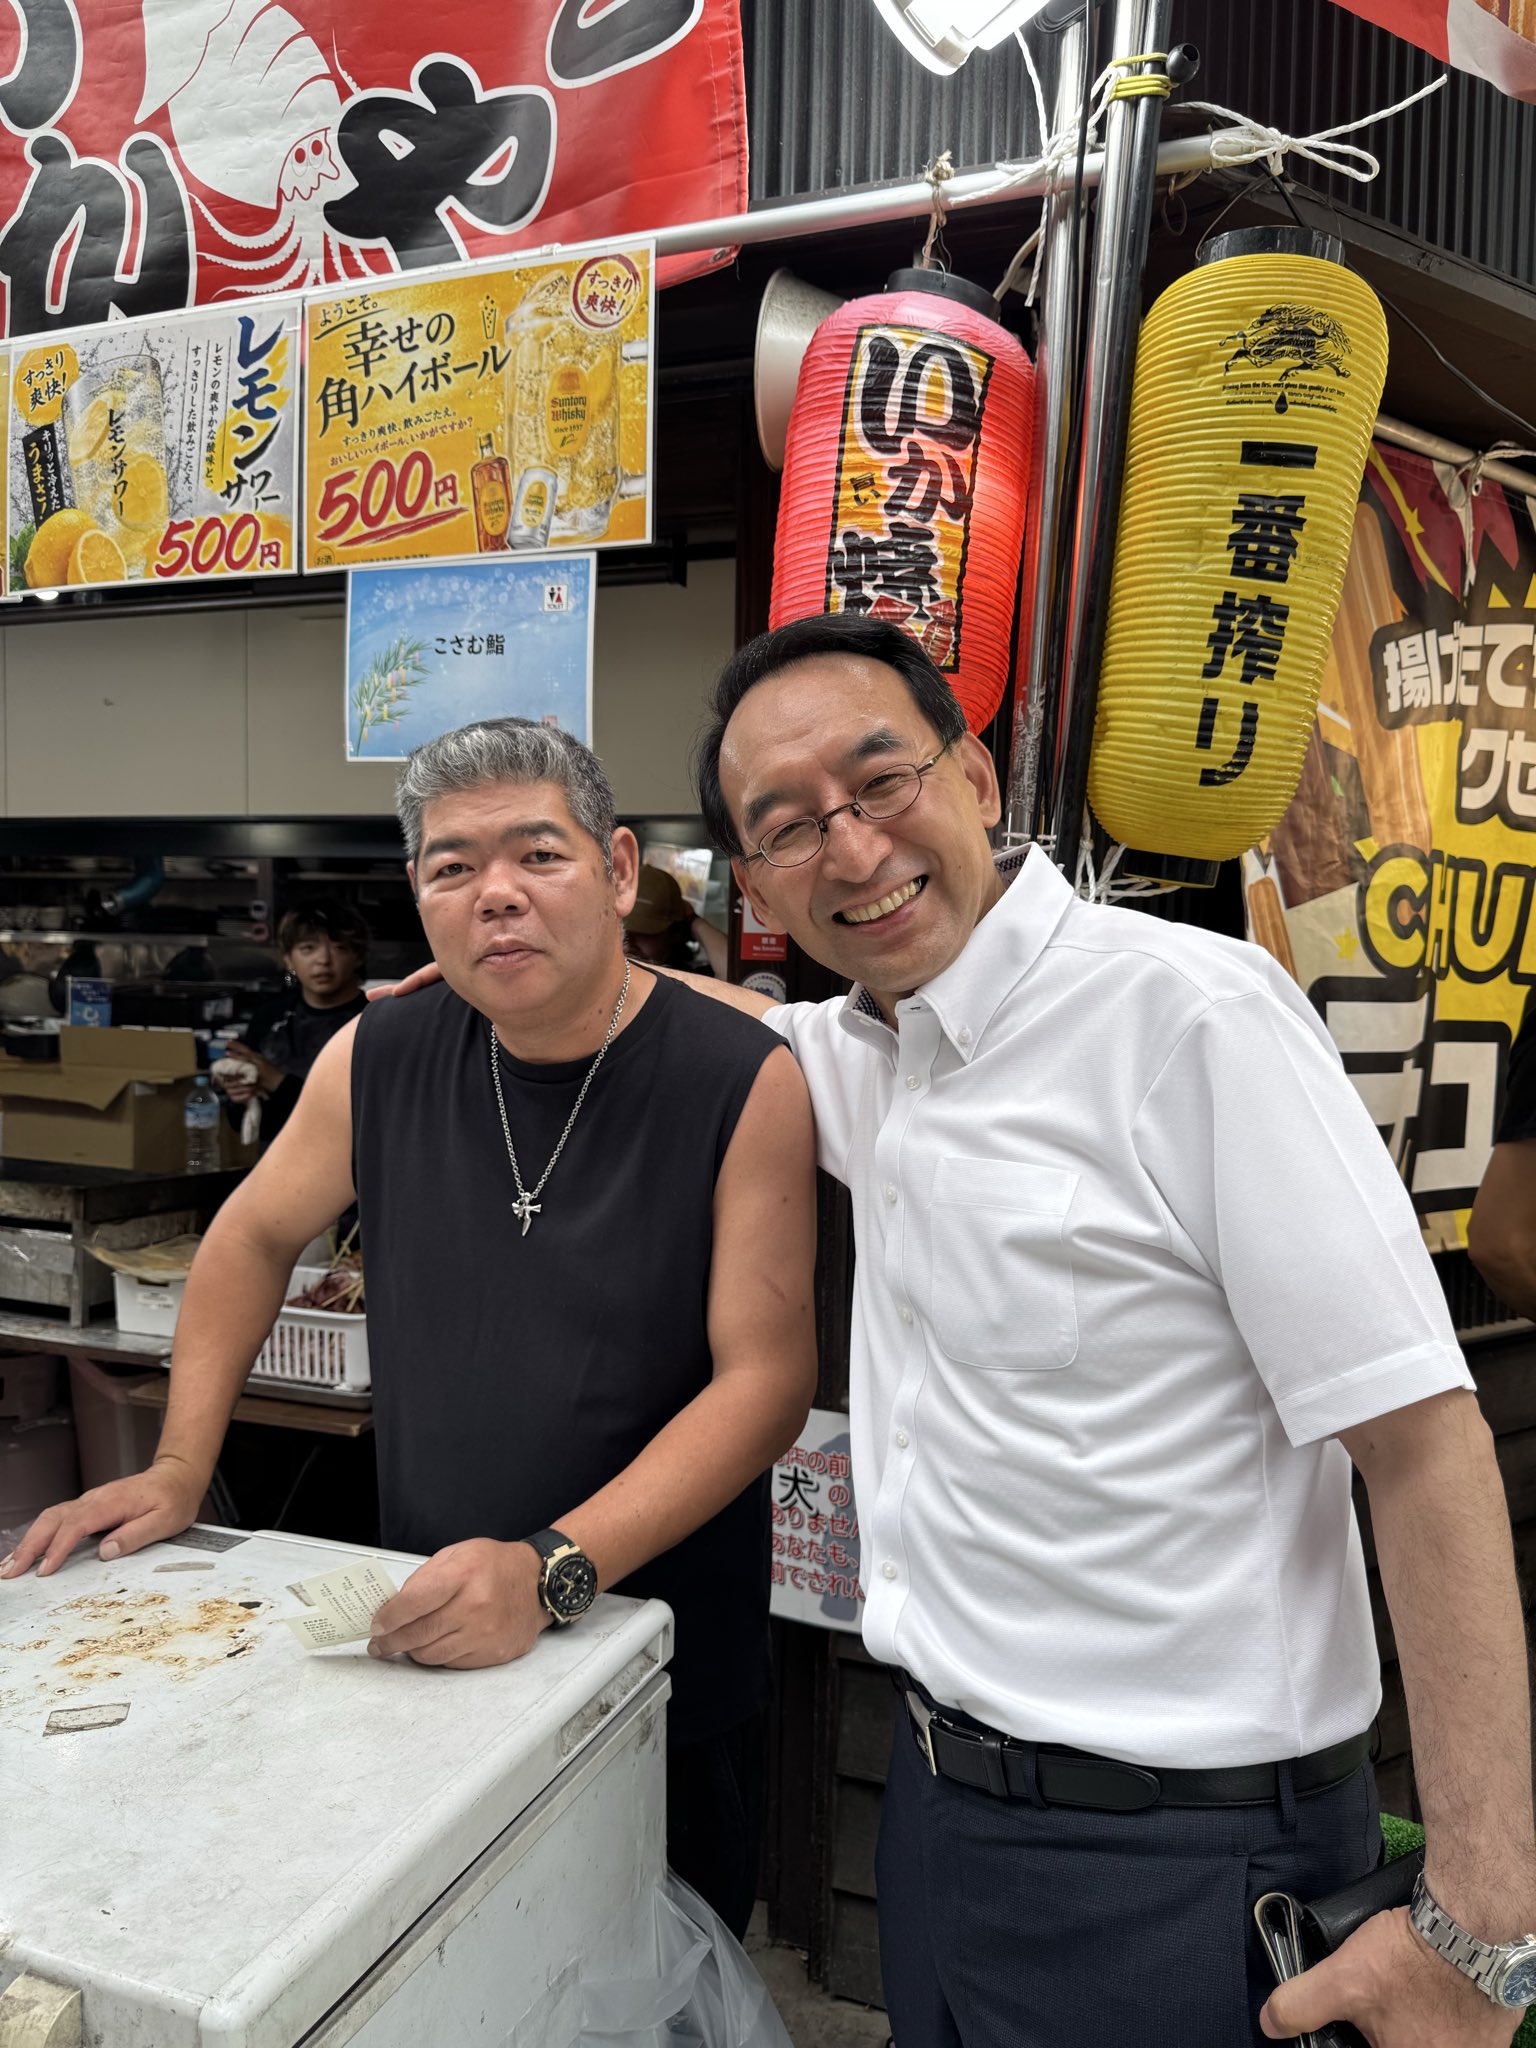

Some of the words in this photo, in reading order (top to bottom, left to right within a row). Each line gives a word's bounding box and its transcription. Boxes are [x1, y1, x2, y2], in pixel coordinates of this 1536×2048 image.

[583, 291, 626, 316] 爽快!
[587, 270, 633, 295] すっきり
[319, 295, 379, 328] ようこそ。
[343, 312, 456, 378] 幸せの
[23, 350, 65, 385] すっきり
[29, 371, 67, 413] 爽快!
[315, 346, 512, 438] 角ハイボール
[551, 396, 587, 408] Suntory
[551, 408, 586, 423] Whisky
[108, 408, 129, 518] レモンサワー
[316, 450, 460, 542] 500円
[155, 513, 282, 578] 500円
[1195, 441, 1318, 787] 一番搾り
[434, 633, 505, 655] こさむ鮨
[1383, 620, 1536, 713] 揚げたて
